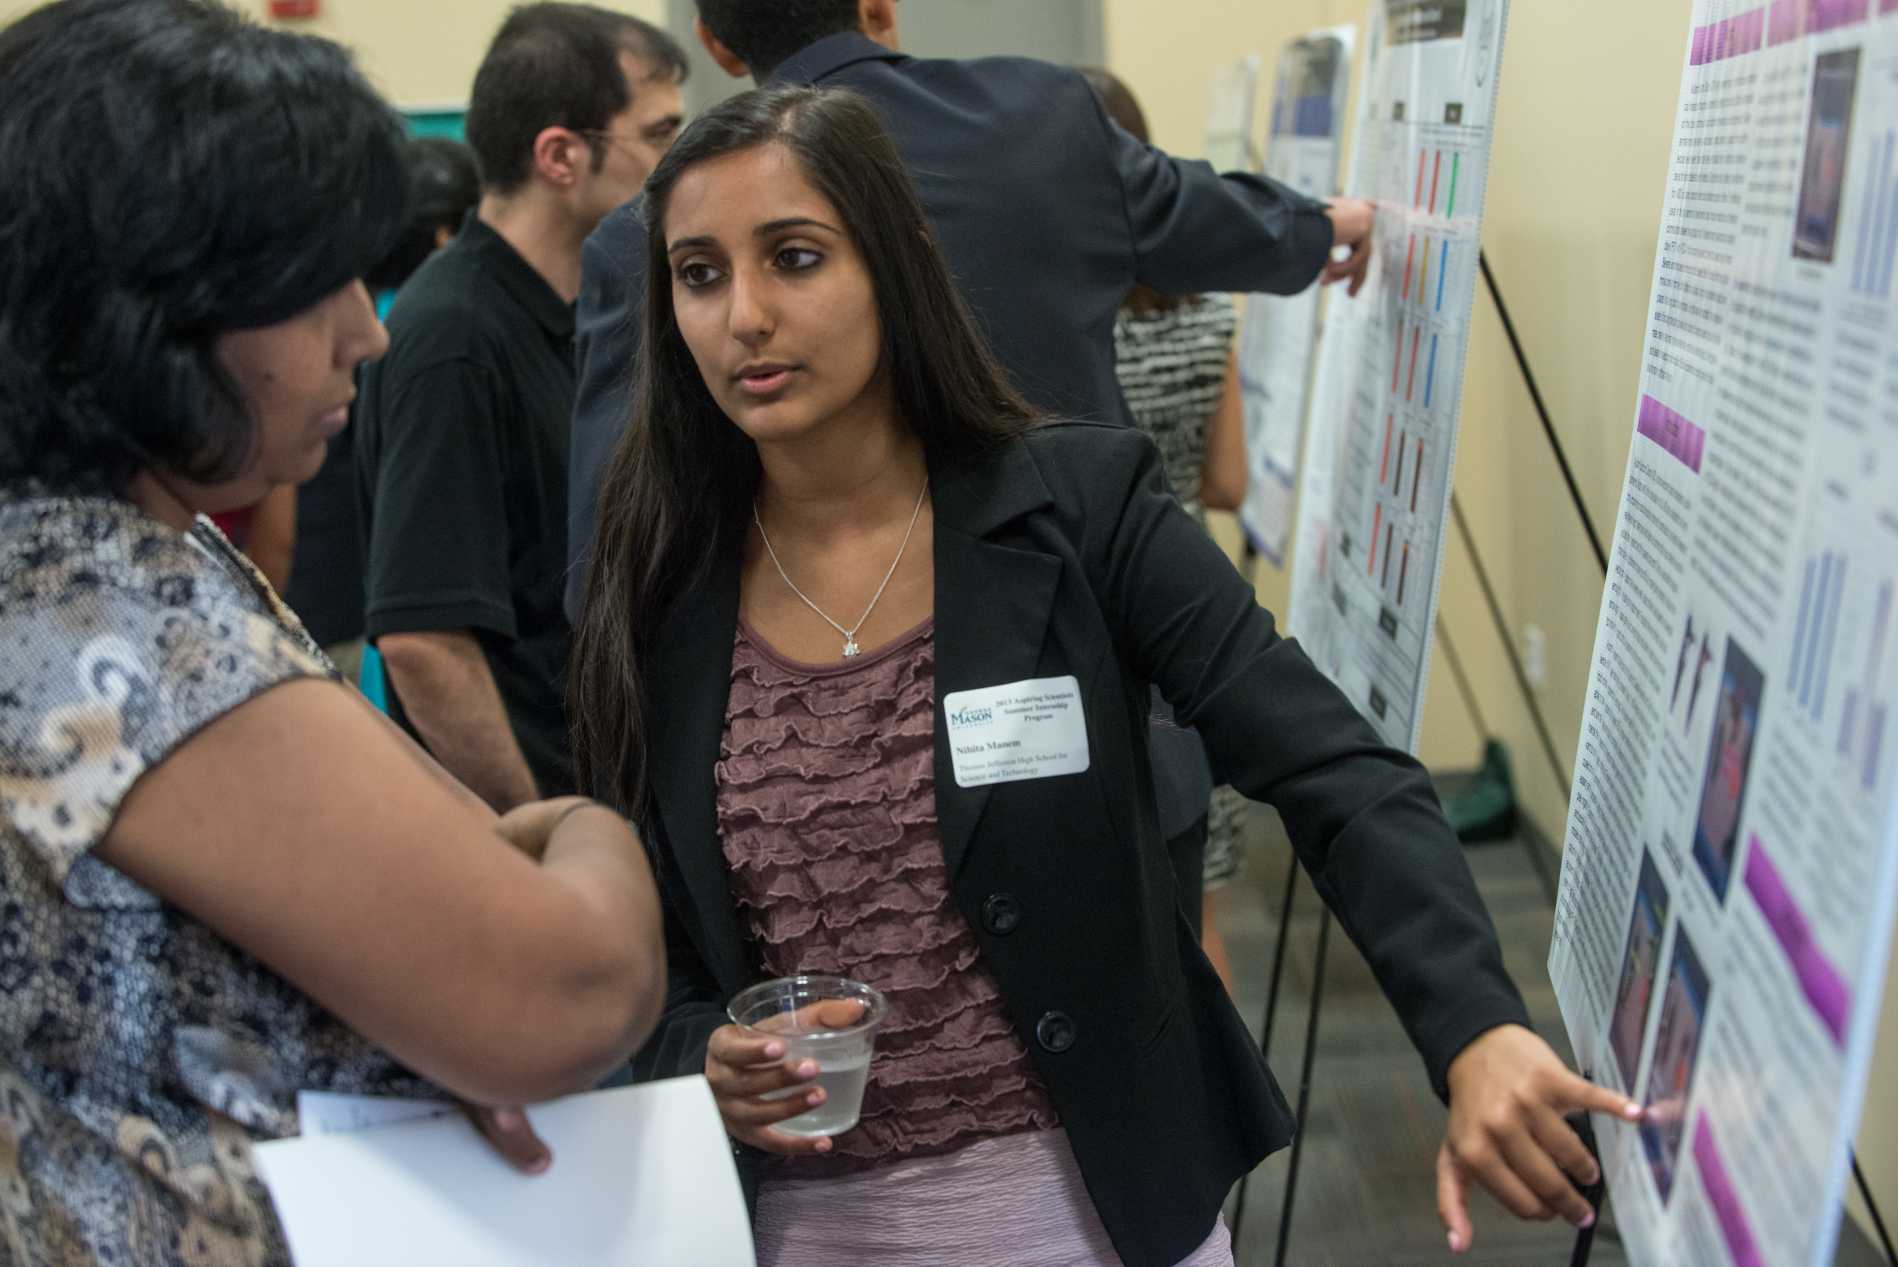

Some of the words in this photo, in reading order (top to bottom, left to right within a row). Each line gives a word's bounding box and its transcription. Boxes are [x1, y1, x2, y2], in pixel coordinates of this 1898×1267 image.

[951, 711, 992, 725] MASON
[1024, 714, 1053, 722] Program
[1035, 753, 1057, 761] School
[1001, 767, 1038, 777] Technology
